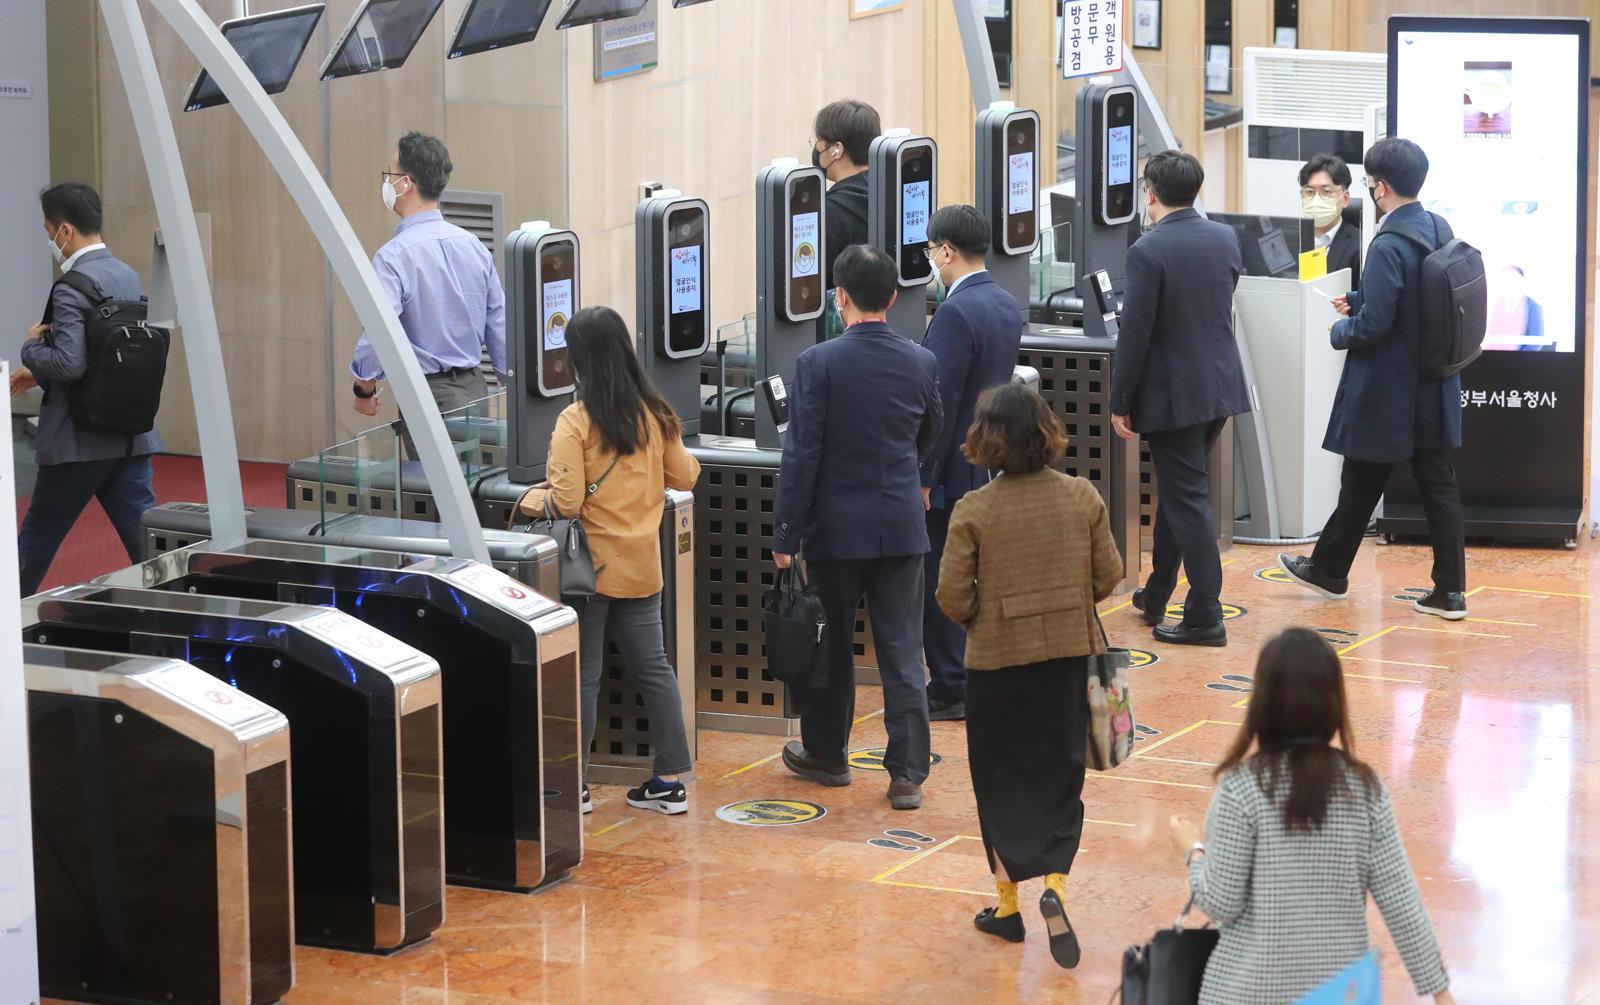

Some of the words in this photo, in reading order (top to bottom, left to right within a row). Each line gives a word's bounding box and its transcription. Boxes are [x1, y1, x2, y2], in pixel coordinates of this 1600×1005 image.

[906, 210, 924, 219] 얼굴인식
[906, 218, 924, 226] 사용중지
[675, 276, 697, 286] 얼굴인식
[675, 285, 697, 294] 사용중지
